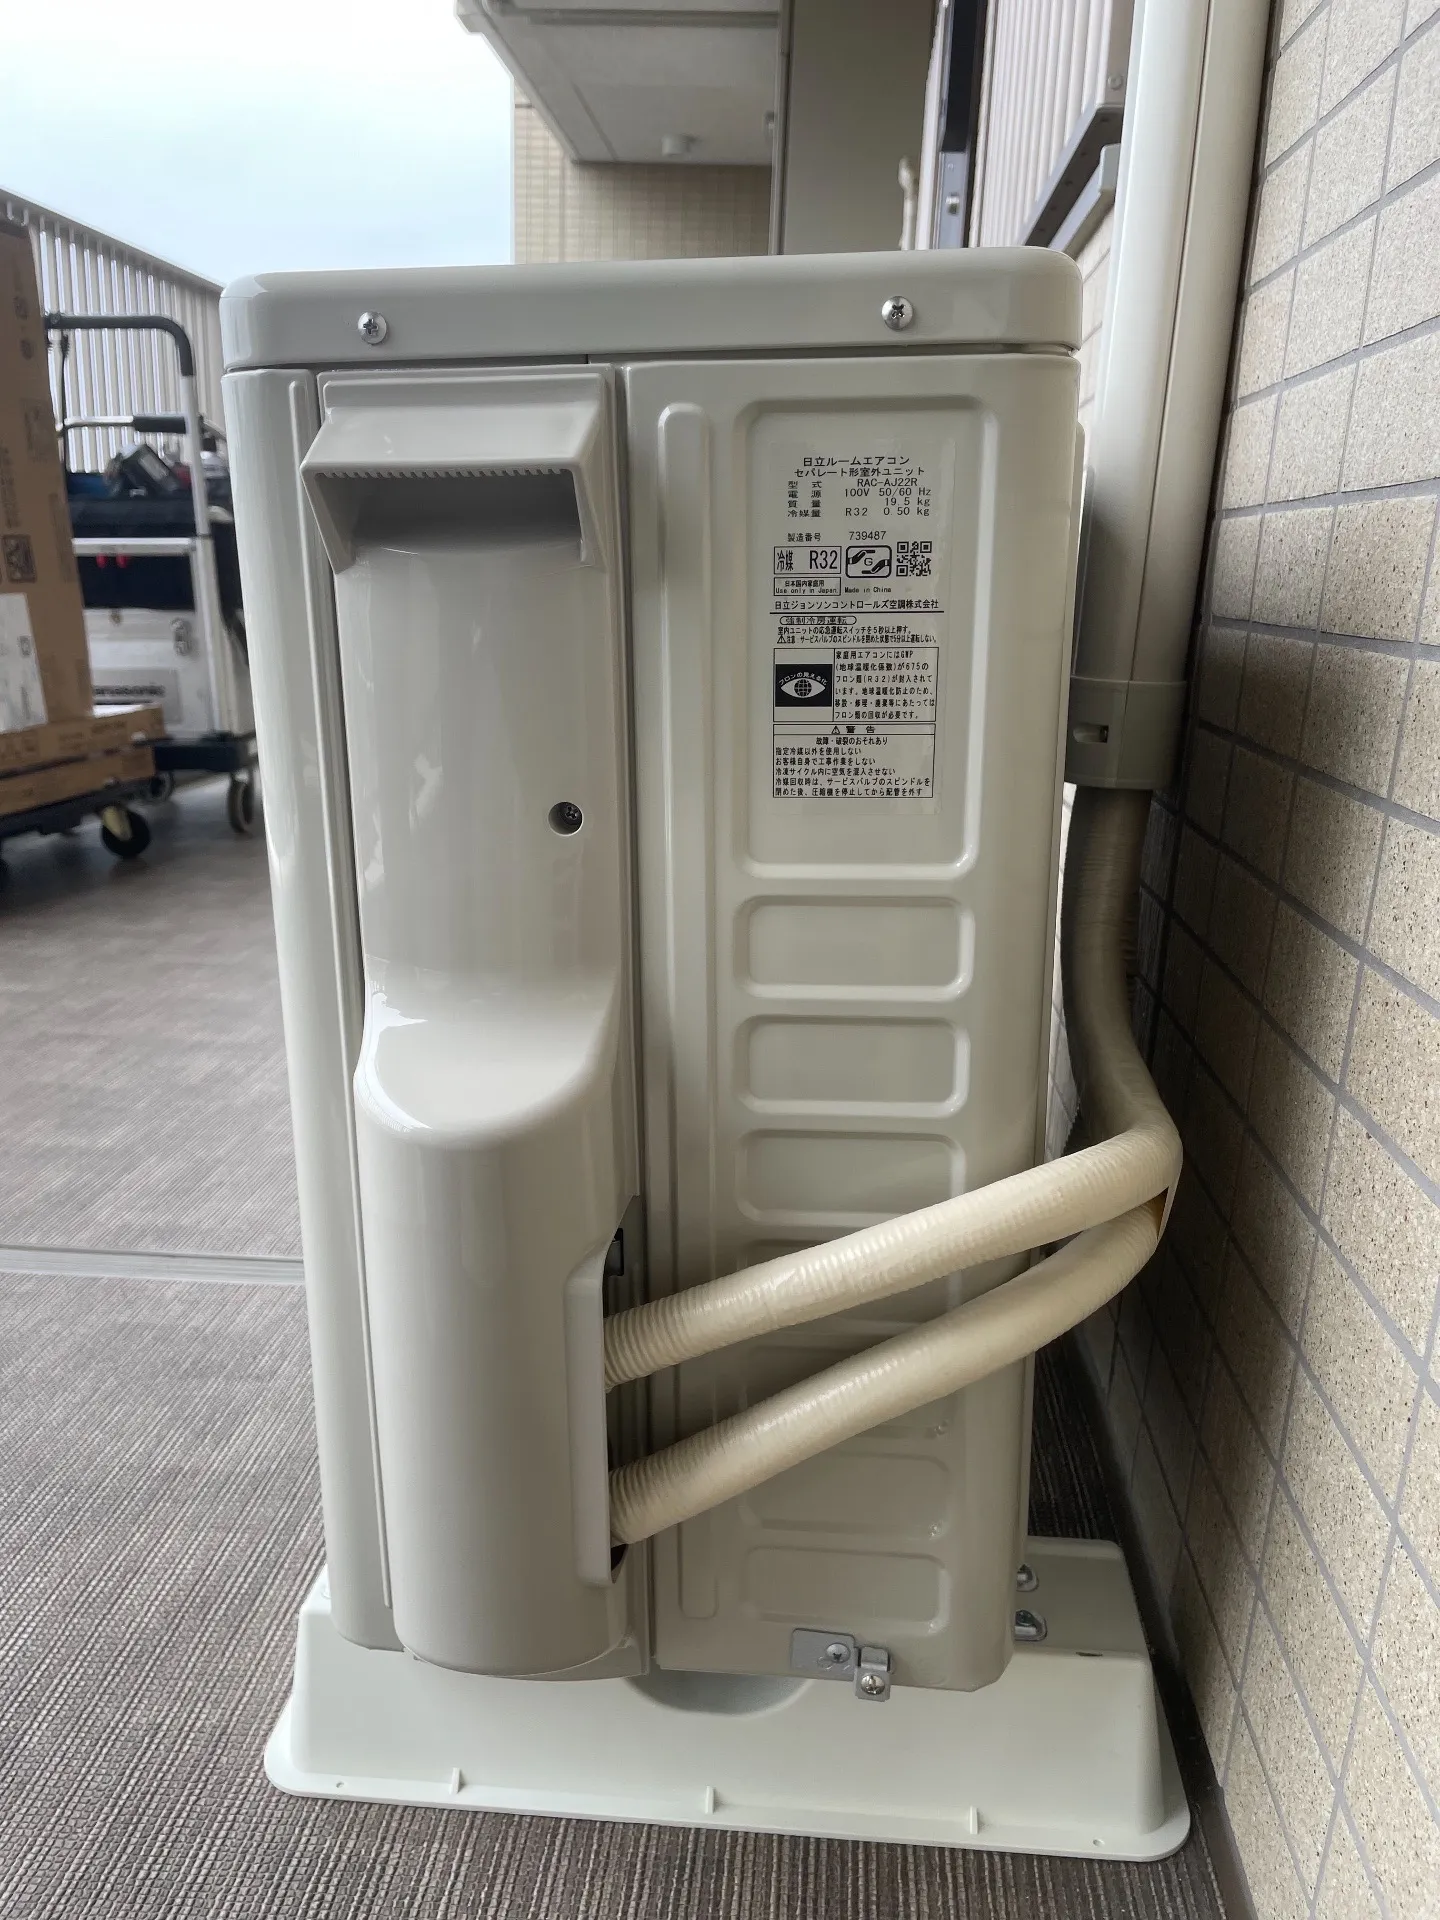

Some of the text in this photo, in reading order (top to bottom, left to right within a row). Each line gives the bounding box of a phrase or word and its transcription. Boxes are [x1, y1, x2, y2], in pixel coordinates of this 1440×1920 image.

[803, 456, 910, 467] 日立ルームエアコン
[794, 467, 925, 477] セパレート形室外ユニット
[857, 478, 918, 487] RAC-AJ22R
[844, 488, 870, 497] 100V
[879, 487, 912, 497] 50/60
[918, 487, 931, 496] Hz
[917, 497, 931, 506] kg
[845, 507, 868, 516] R32
[917, 507, 930, 516] kg
[787, 531, 887, 542] 製造番号 739487
[777, 550, 838, 571] 冷媒 R32
[863, 558, 873, 566] G
[774, 599, 939, 610] 日立ジョンソンコントロールズ空調株式会社
